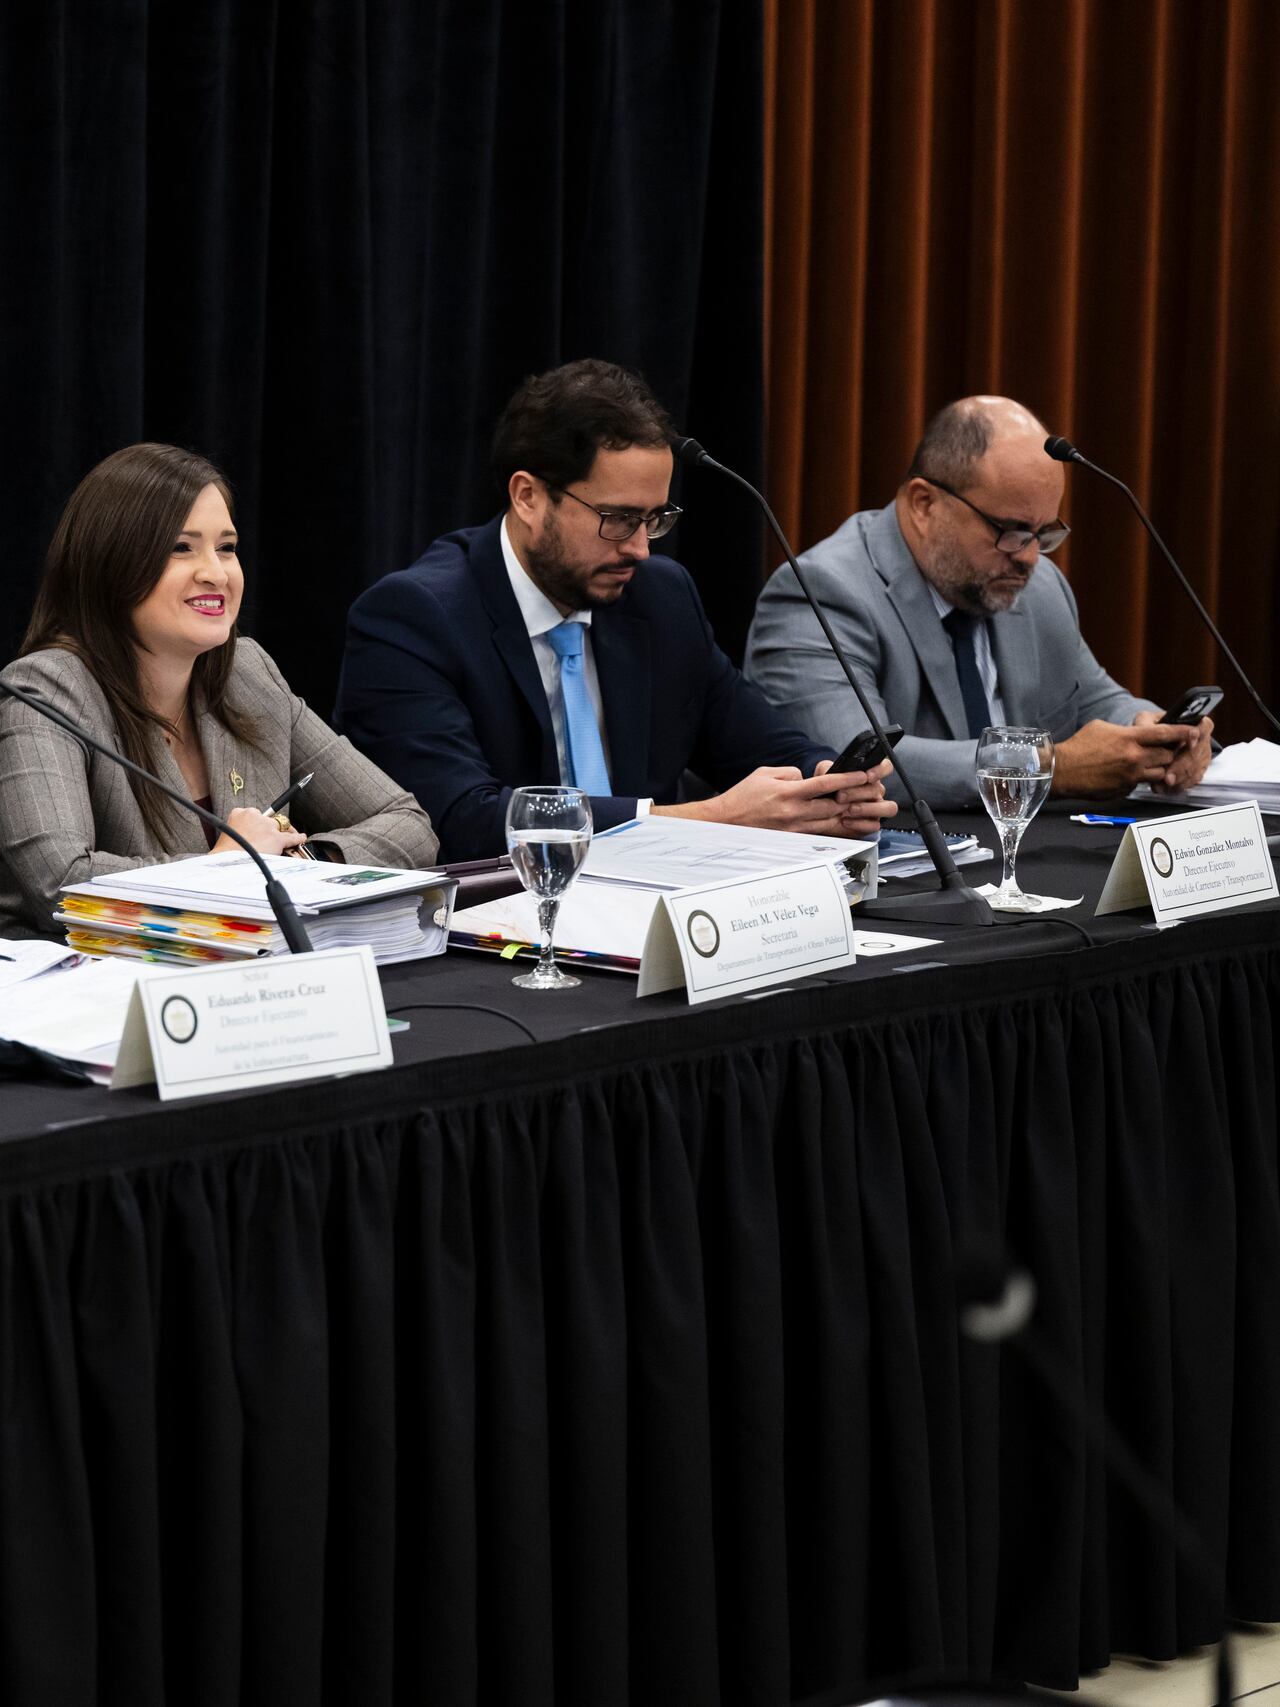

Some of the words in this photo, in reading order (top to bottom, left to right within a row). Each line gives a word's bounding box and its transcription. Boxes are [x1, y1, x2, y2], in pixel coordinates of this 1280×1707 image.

[1174, 848, 1196, 860] Edwin
[1196, 843, 1225, 856] González
[1225, 837, 1254, 851] Montalvo
[1183, 865, 1209, 877] Director
[748, 888, 791, 908] Honorable
[730, 917, 759, 932] Eileen
[759, 913, 773, 925] M.
[773, 908, 797, 921] Vélez
[797, 904, 819, 917] Vega
[761, 927, 798, 945] Secretaria
[208, 991, 257, 1008] Eduardo
[258, 988, 296, 1002] Rivera
[298, 982, 327, 996] Cruz
